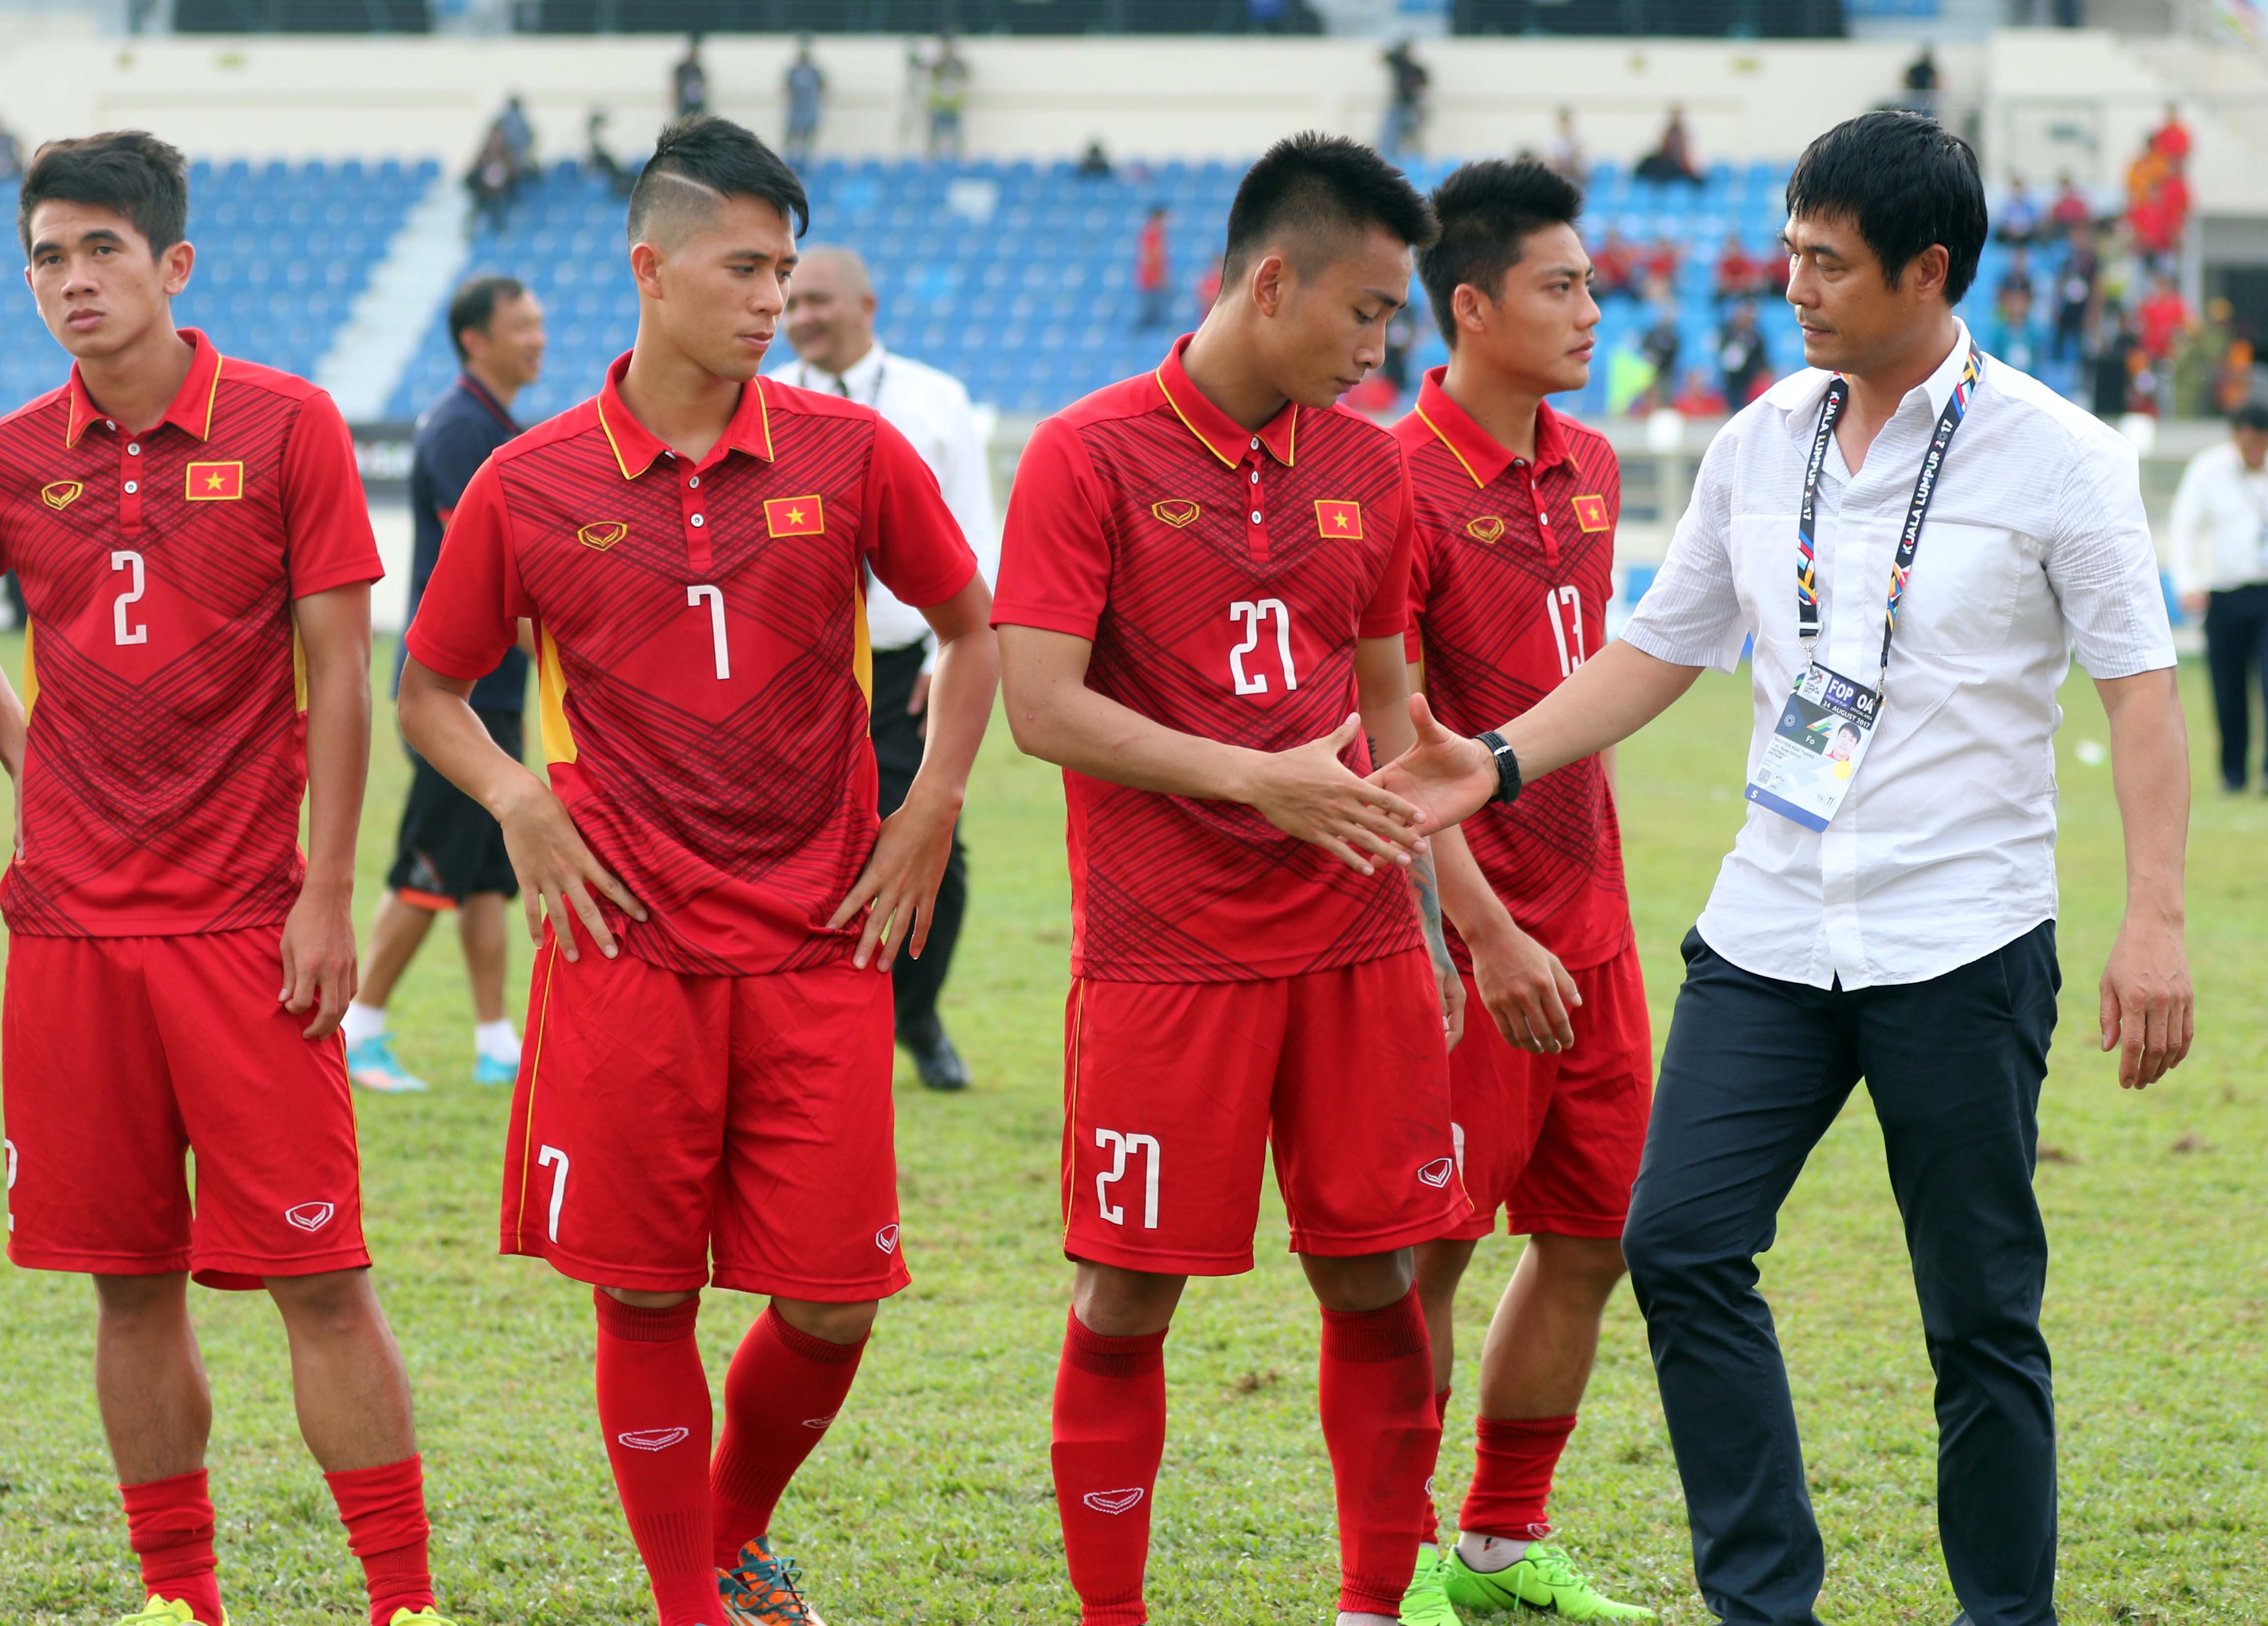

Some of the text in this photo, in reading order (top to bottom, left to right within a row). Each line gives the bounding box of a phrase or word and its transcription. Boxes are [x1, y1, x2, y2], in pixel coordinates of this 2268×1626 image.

[1820, 391, 1841, 433] KUALA
[1807, 434, 1826, 486] LUMPUR
[1901, 509, 1923, 555] KUALA
[1915, 451, 1941, 506] LUMPUR
[111, 550, 147, 646] 2
[687, 585, 730, 680] 7
[1547, 585, 1585, 678] 13
[1229, 598, 1296, 696] 27
[1823, 700, 1871, 728] 24 AUGUST 2017
[1828, 679, 1854, 701] FOP
[1856, 694, 1874, 714] OA
[1805, 735, 1816, 745] Fo
[1750, 790, 1759, 798] S
[538, 1145, 569, 1244] 7
[1095, 1128, 1160, 1229] 27
